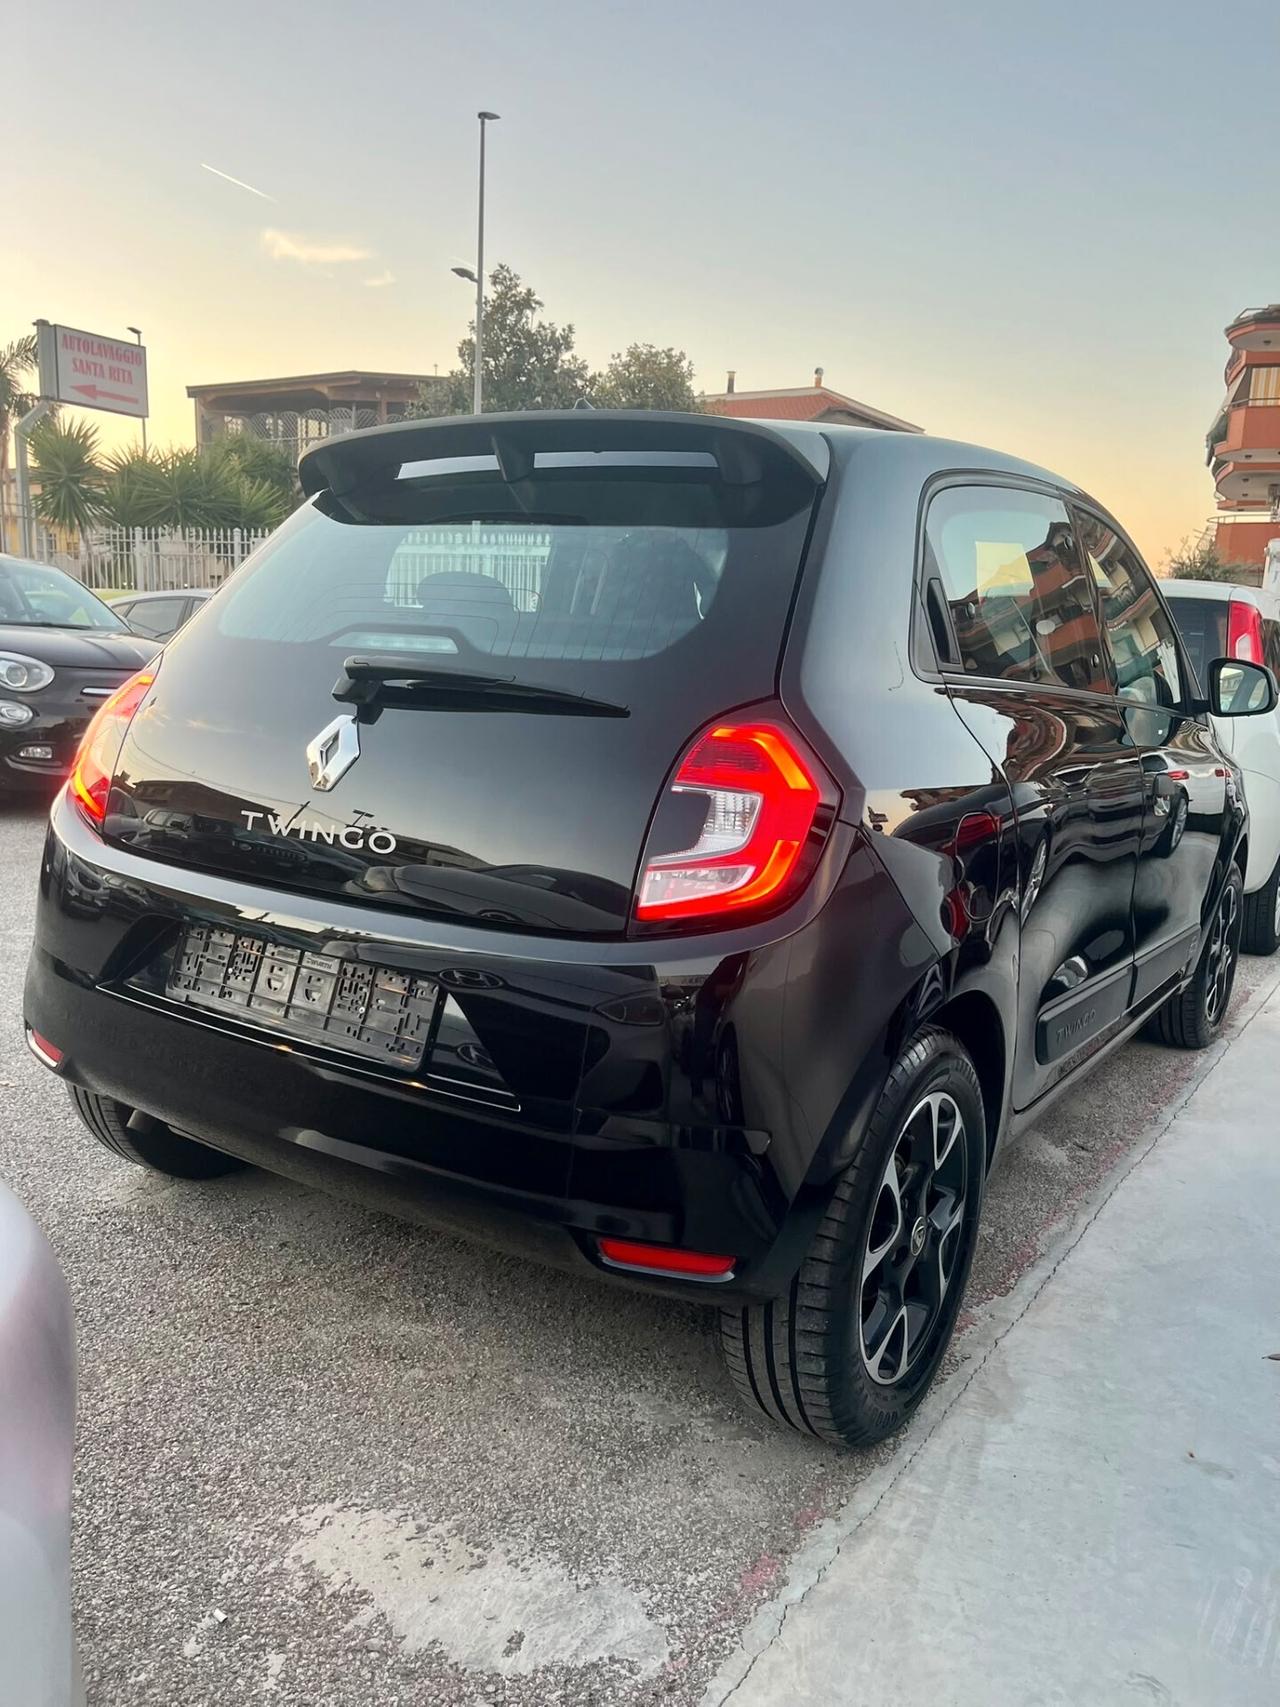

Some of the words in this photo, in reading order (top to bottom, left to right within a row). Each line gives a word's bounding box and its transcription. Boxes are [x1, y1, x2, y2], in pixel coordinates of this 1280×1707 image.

[62, 334, 142, 367] AUTOLAVAGGIO
[72, 357, 105, 379] SANTA
[108, 365, 133, 385] RITA
[240, 809, 397, 854] TWINGO
[1056, 1008, 1096, 1044] TWINGO
